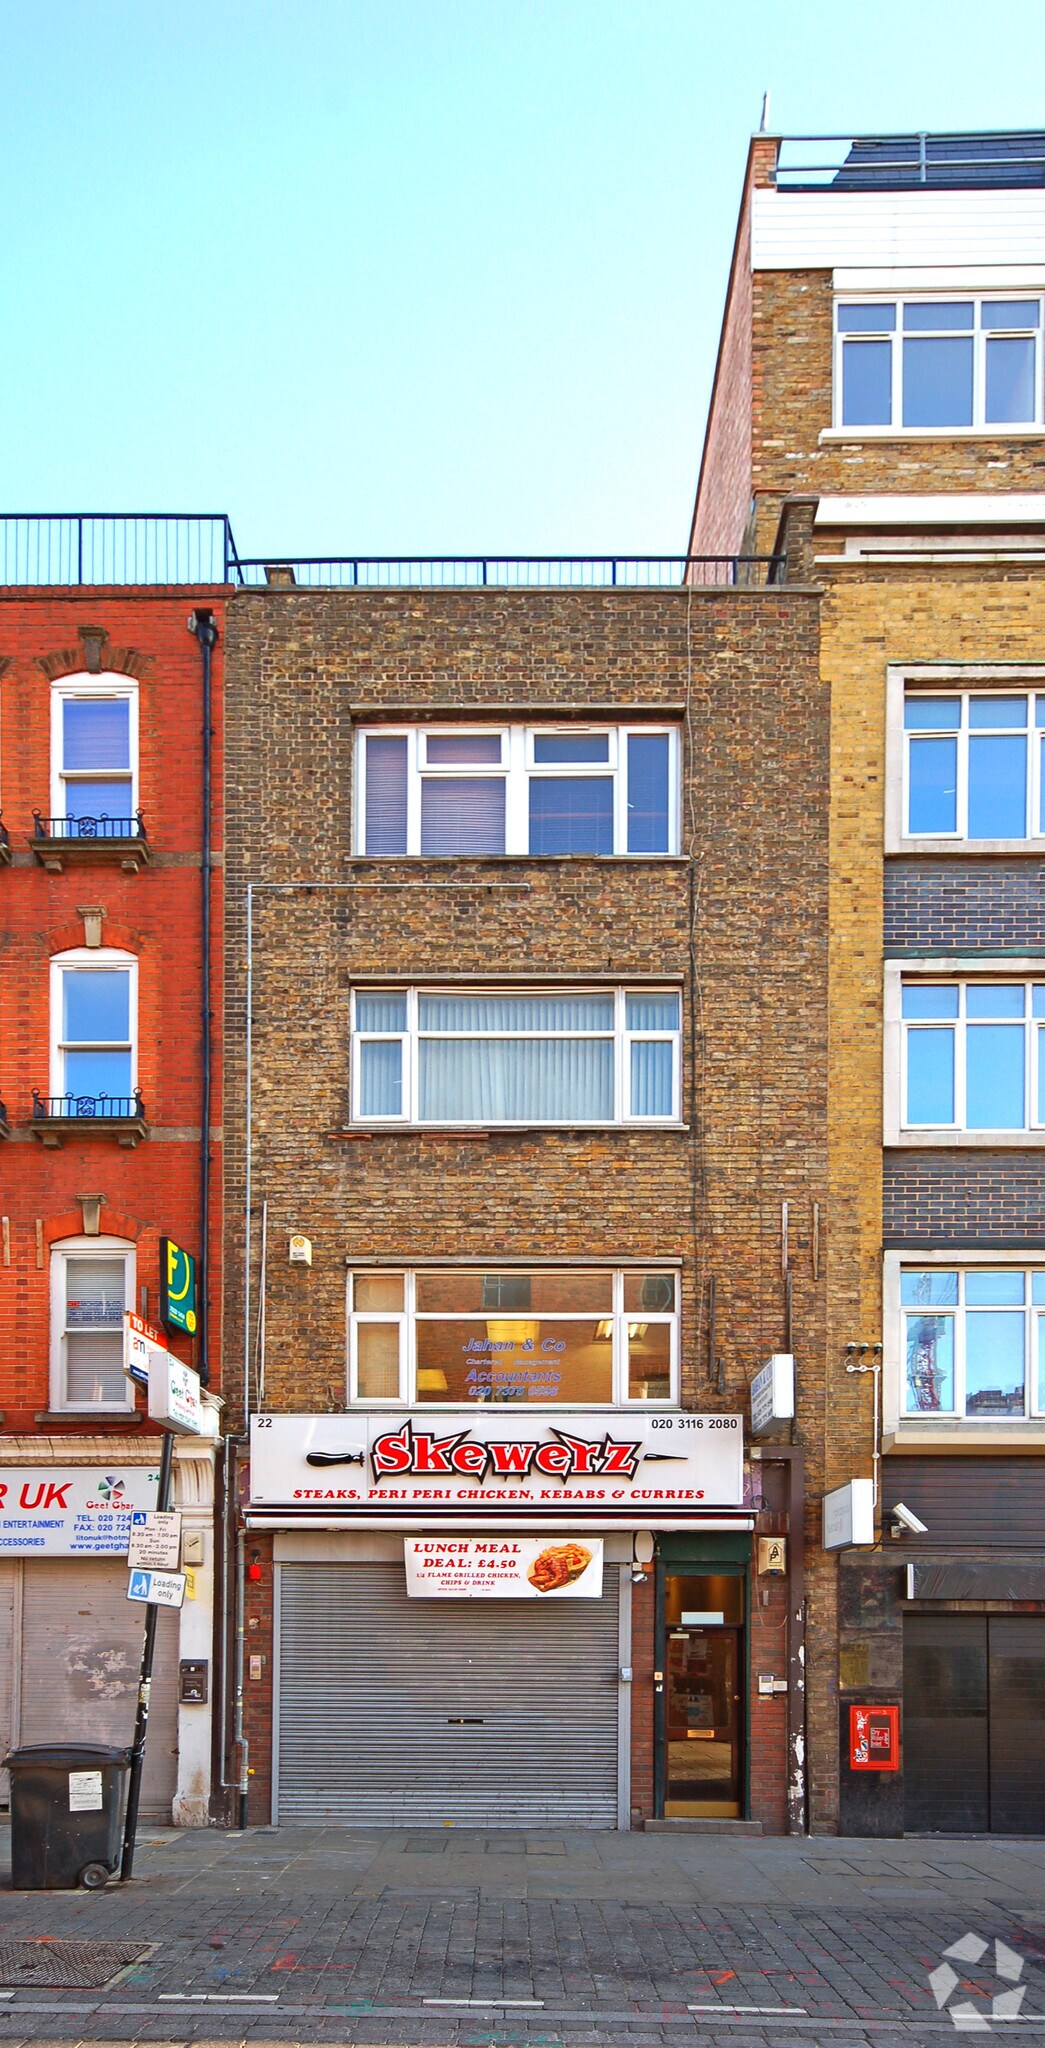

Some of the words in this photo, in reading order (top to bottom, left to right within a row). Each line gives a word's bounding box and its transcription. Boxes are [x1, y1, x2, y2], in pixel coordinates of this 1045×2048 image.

[132, 1316, 143, 1332] TO
[144, 1324, 158, 1341] LET
[462, 1338, 514, 1352] Jahan
[521, 1338, 534, 1352] &
[541, 1338, 566, 1352] Co
[465, 1368, 562, 1383] Accountants
[468, 1386, 492, 1396] 020
[257, 1418, 273, 1428] 22
[651, 1418, 673, 1429] 020
[678, 1418, 704, 1429] 3116
[708, 1418, 738, 1429] 2080
[370, 1420, 642, 1485] Skewerz
[19, 1483, 73, 1509] UK
[293, 1490, 360, 1500] STEAKS,
[368, 1490, 407, 1499] PERI
[413, 1490, 451, 1499] PERI
[457, 1490, 534, 1500] CHICKEN,
[540, 1490, 605, 1499] KEBABS
[611, 1490, 625, 1499] &
[630, 1490, 705, 1499] CURRIES
[86, 1501, 109, 1509] Geet
[112, 1501, 134, 1510] Ghar
[3, 1520, 64, 1528] ENTERTAINMENT
[413, 1543, 469, 1553] LUNCH
[474, 1543, 521, 1553] MEAL
[423, 1558, 472, 1568] DEAL:
[477, 1559, 516, 1568] £4.50
[153, 1578, 182, 1592] Loading
[158, 1590, 174, 1600] only
